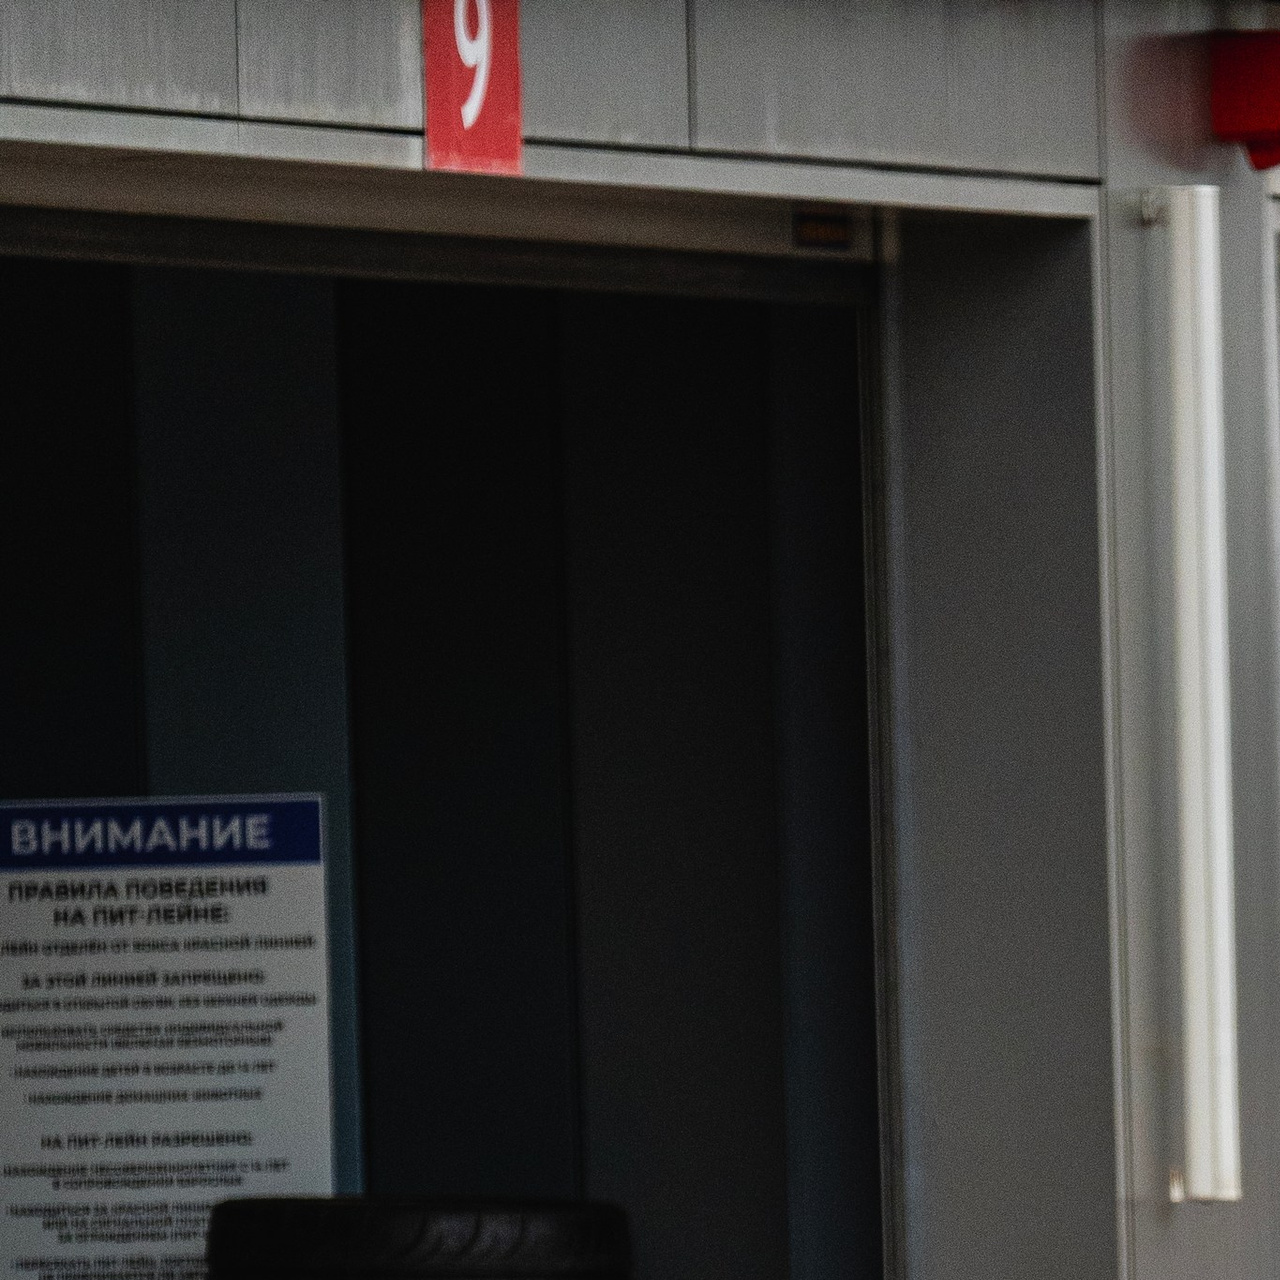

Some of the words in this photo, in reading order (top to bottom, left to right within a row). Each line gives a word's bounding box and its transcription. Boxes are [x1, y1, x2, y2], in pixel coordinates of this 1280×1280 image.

[454, 0, 494, 129] 9
[10, 813, 272, 855] ВНИМАНИЕ
[7, 879, 118, 901] ПРАВИЛА
[125, 875, 268, 900] ПОВЕДЕНИЯ
[53, 907, 86, 926] НА
